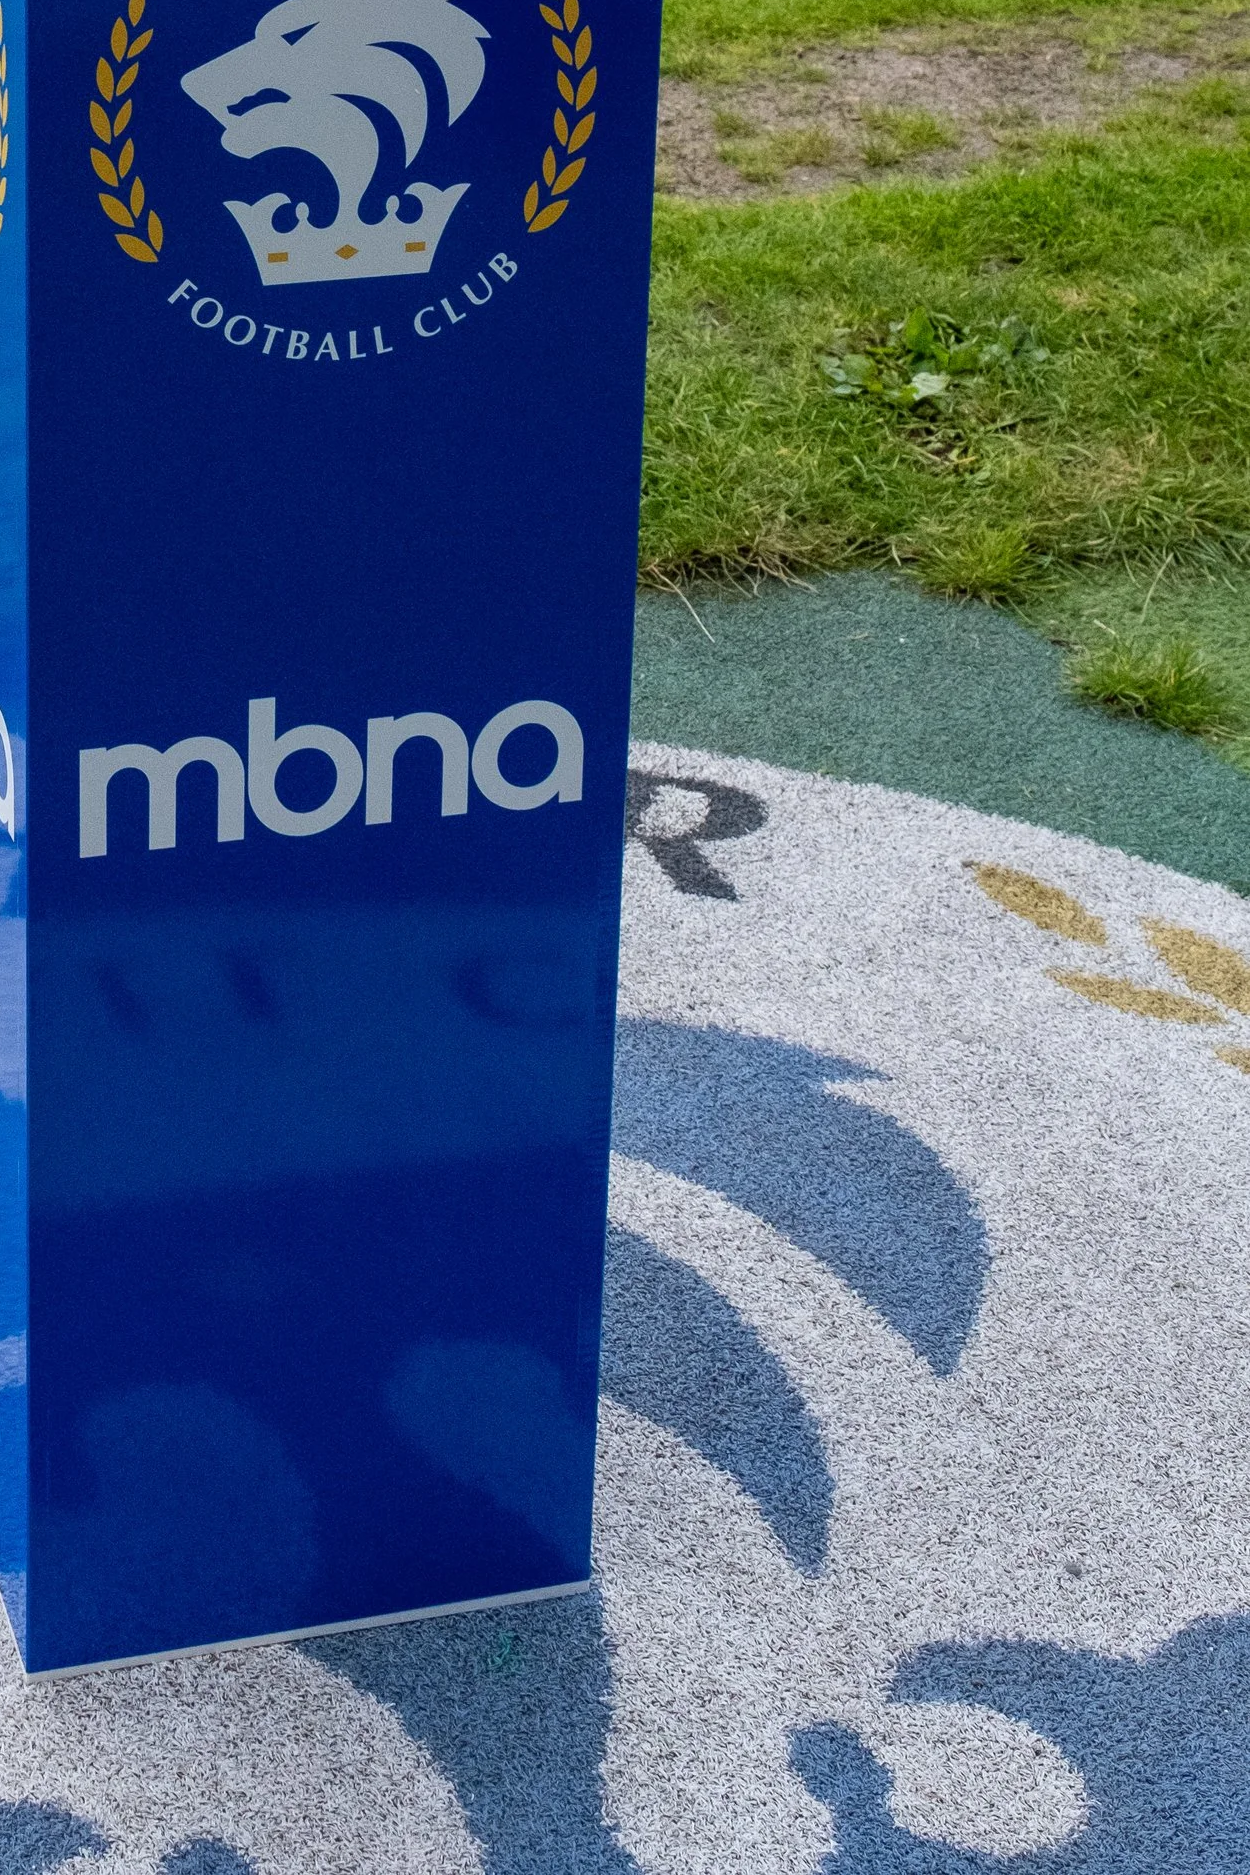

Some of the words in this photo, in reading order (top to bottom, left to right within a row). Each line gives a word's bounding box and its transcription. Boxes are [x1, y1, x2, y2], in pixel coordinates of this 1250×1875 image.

[167, 278, 393, 362] FOOTBALL
[413, 251, 519, 337] CLUB
[80, 697, 584, 858] mbna
